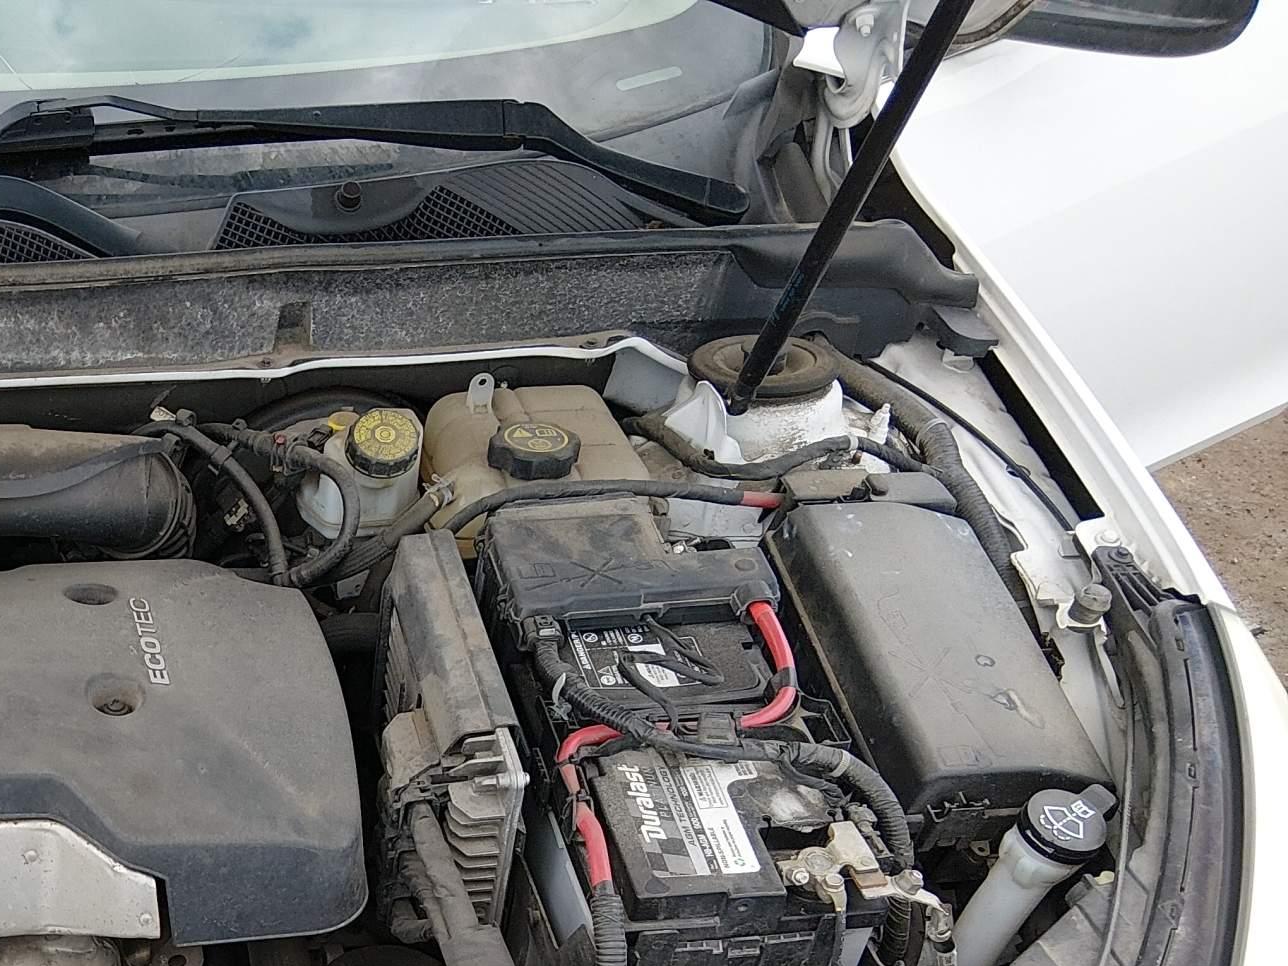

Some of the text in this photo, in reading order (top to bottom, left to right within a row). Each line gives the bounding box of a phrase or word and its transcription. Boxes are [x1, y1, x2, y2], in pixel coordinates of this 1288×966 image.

[129, 597, 170, 685] ECOTEC
[616, 763, 668, 843] Duralast
[658, 766, 688, 824] TECHNOLOGY
[681, 829, 698, 847] AGM
